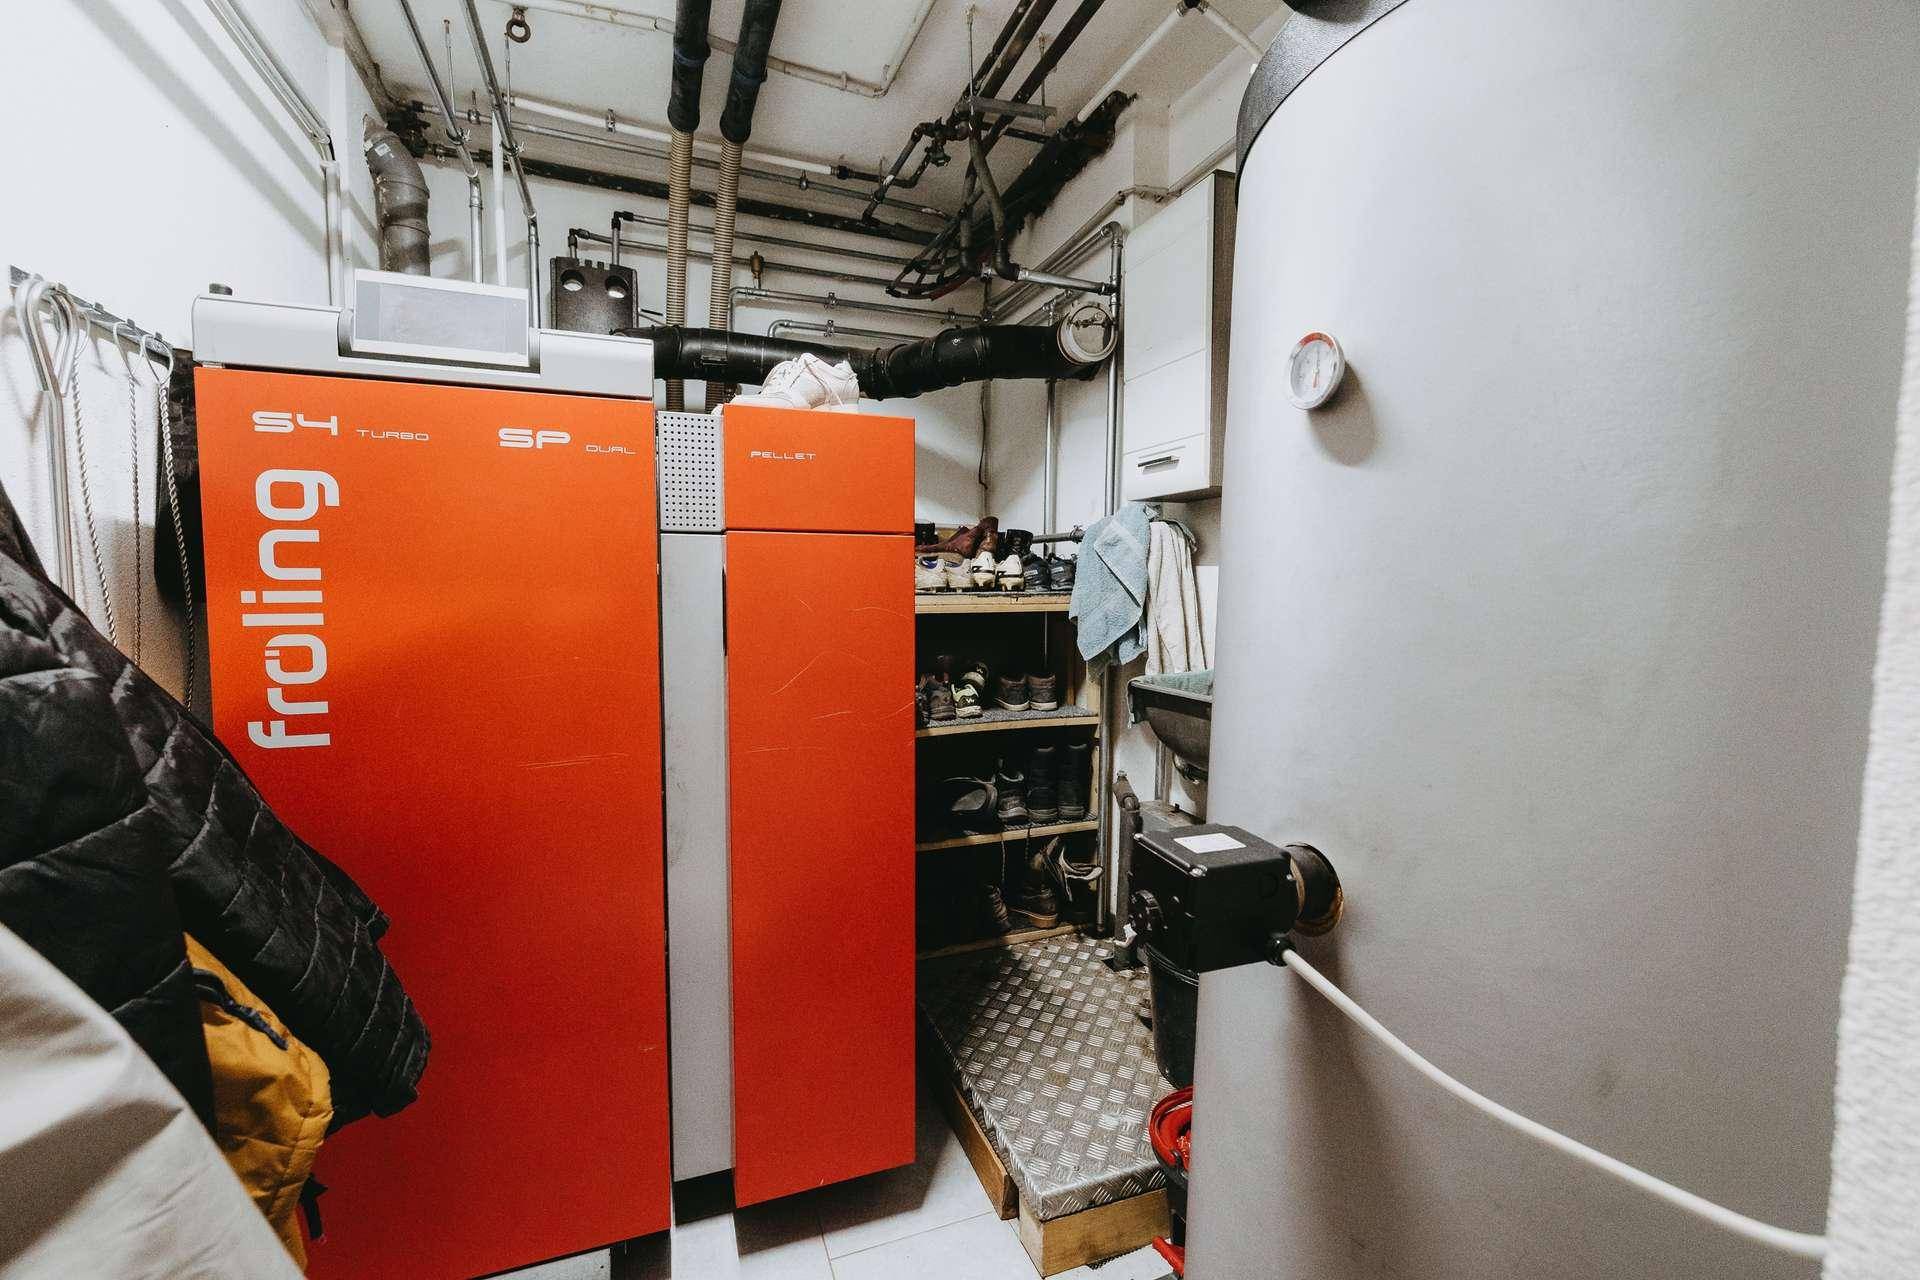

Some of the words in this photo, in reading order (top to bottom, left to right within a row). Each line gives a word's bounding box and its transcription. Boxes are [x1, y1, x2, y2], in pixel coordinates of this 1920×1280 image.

[252, 411, 338, 436] S4
[356, 429, 430, 441] TURBO
[498, 427, 572, 449] SP
[585, 444, 636, 455] DUAL
[750, 450, 817, 461] PELLET
